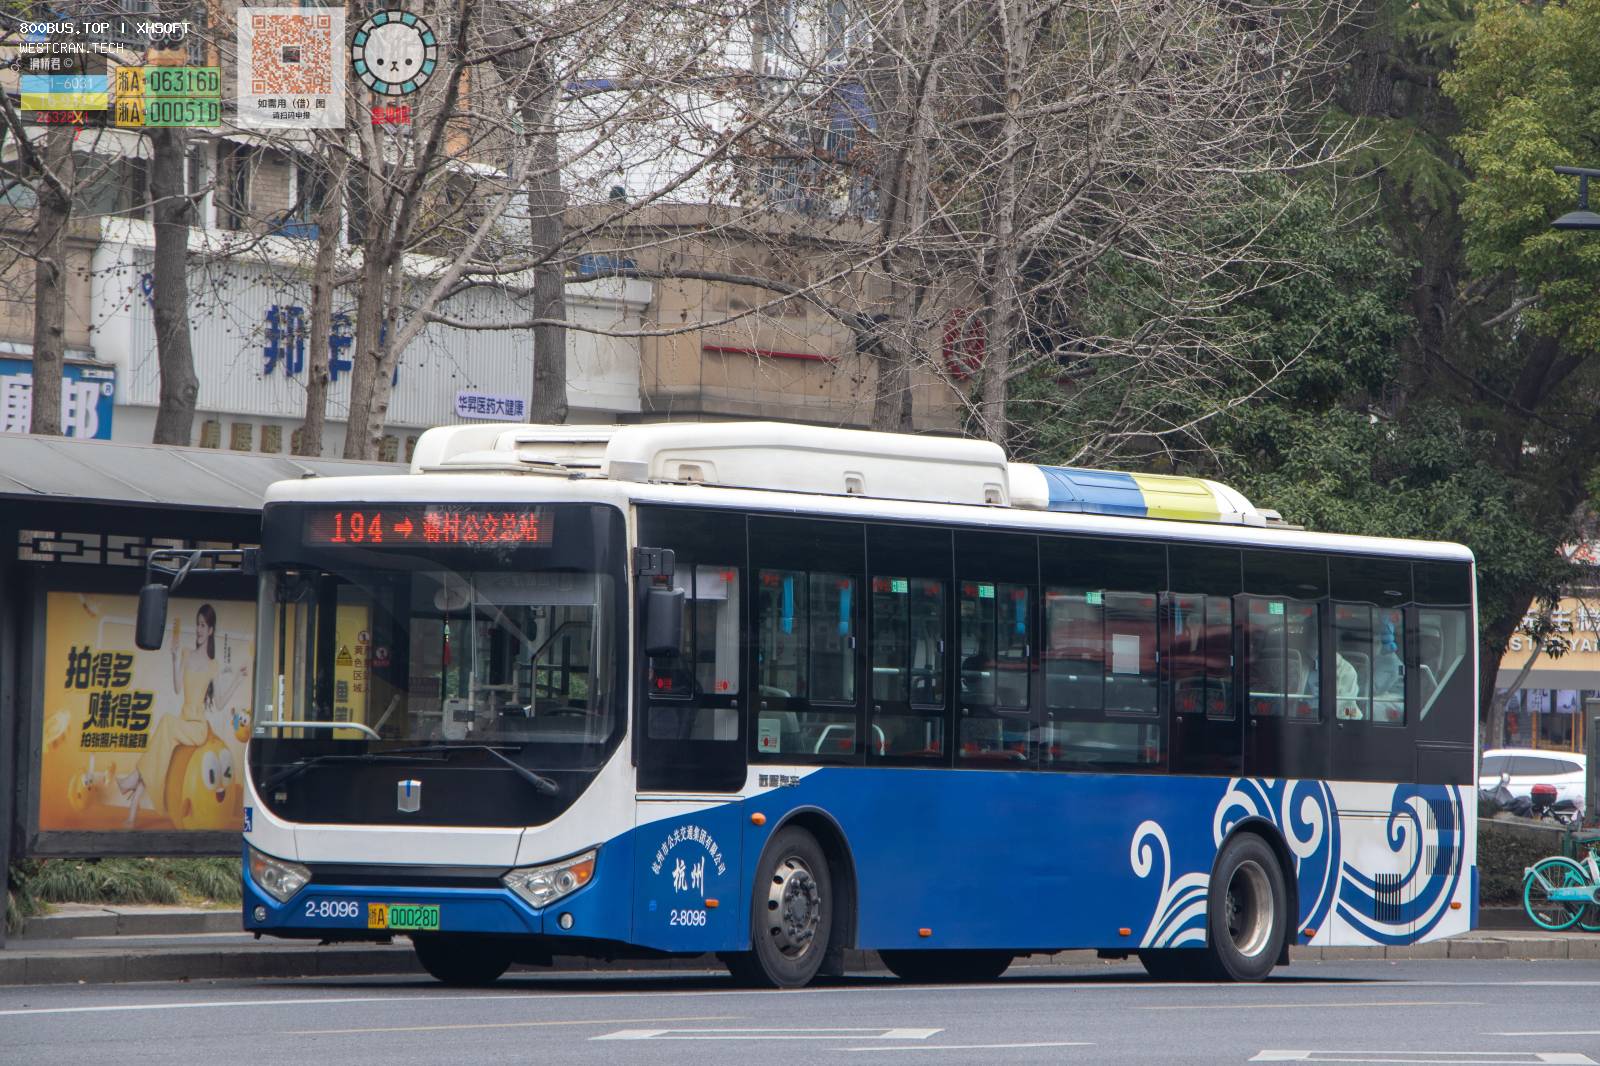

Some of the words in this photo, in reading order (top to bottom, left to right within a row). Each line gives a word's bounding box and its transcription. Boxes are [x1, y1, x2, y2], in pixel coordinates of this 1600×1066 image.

[330, 511, 383, 543] 194
[64, 645, 133, 689] 拍得多
[82, 691, 153, 731] 赚得多
[650, 825, 727, 876] 杭州市公共交通集团有限公司
[672, 855, 705, 897] 杭州
[305, 901, 359, 917] 2-8096
[391, 908, 438, 927] 00028D
[670, 909, 707, 926] 2-8096
